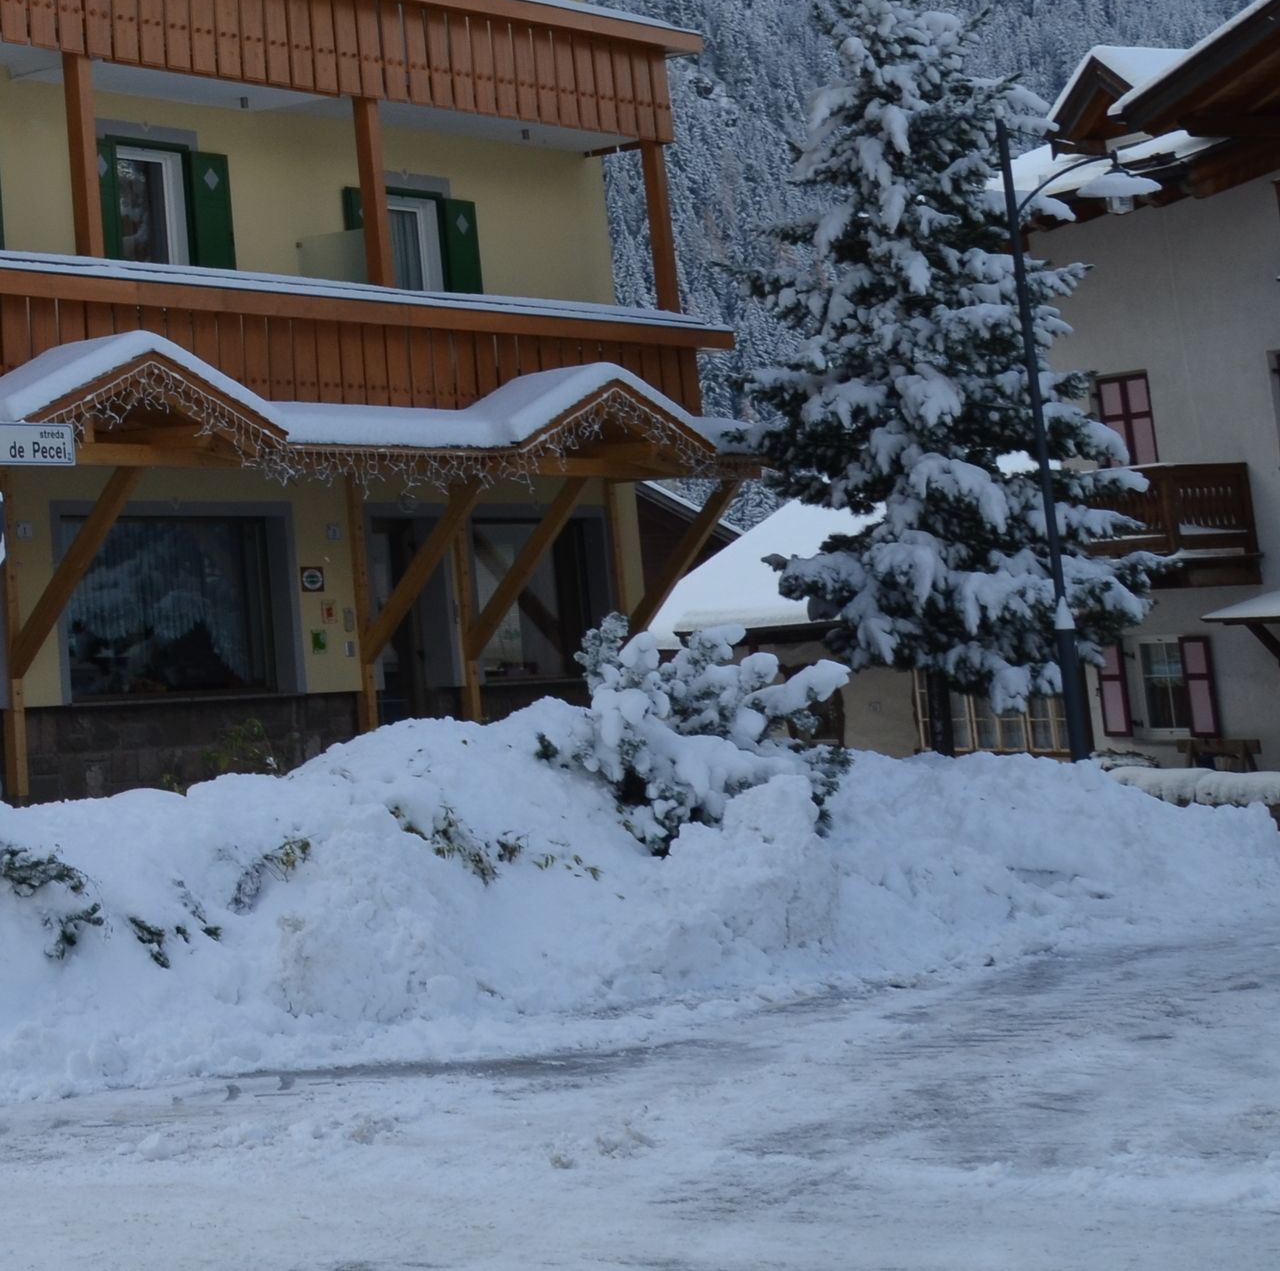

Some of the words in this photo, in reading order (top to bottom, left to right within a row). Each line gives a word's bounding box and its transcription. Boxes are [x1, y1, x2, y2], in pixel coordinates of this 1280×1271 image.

[39, 429, 65, 439] streda
[9, 440, 25, 458] de
[32, 441, 67, 459] Pecei
